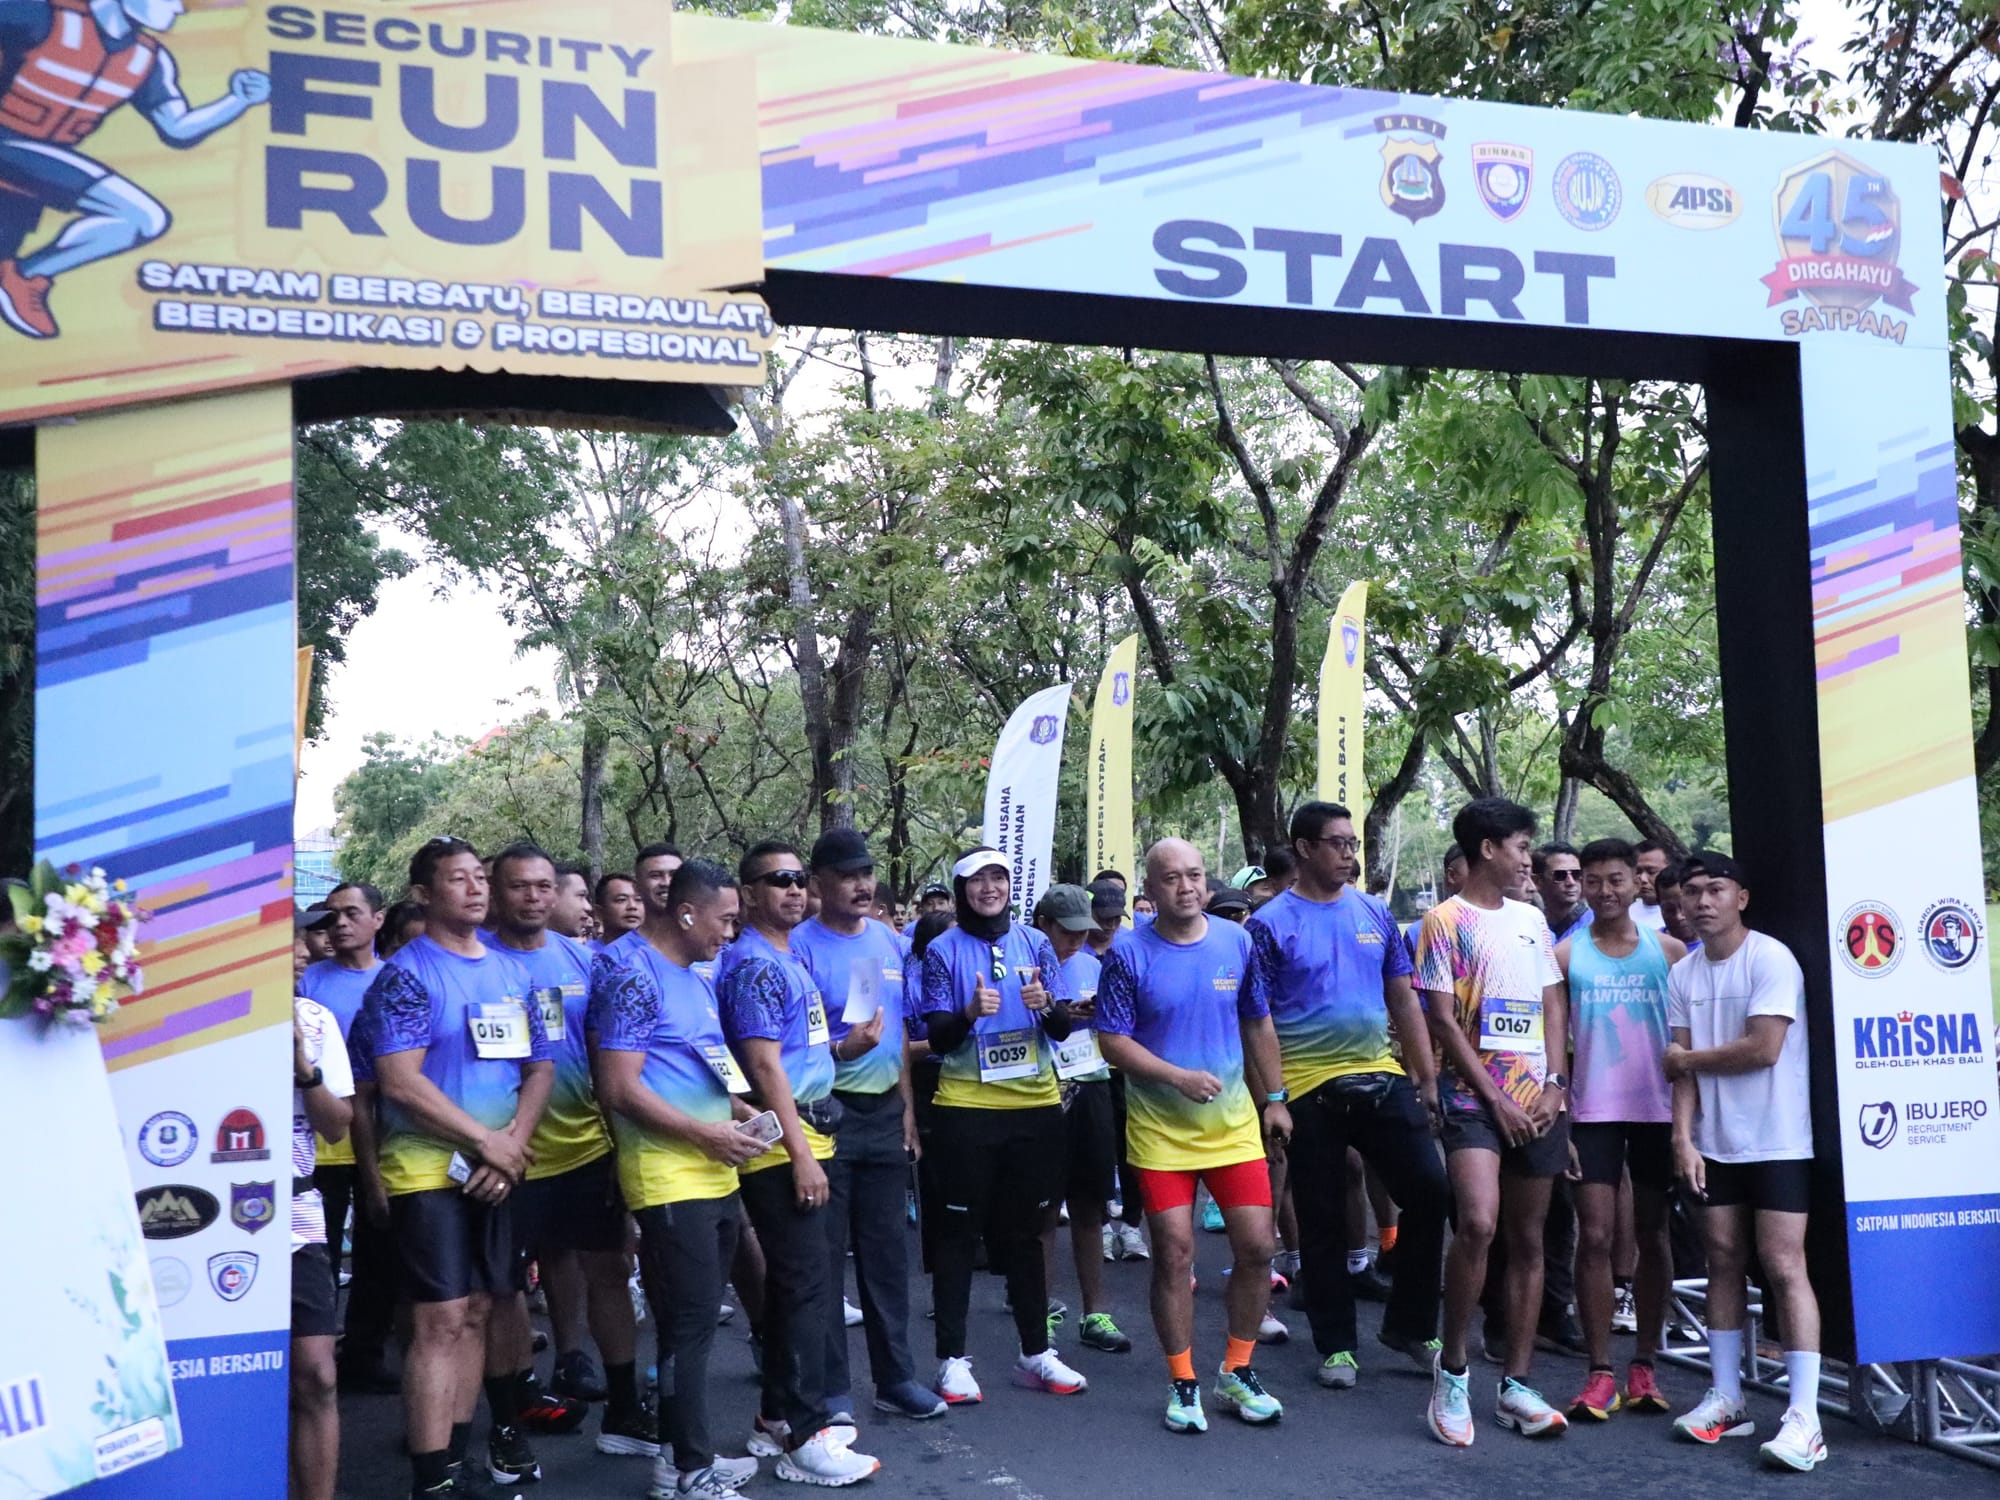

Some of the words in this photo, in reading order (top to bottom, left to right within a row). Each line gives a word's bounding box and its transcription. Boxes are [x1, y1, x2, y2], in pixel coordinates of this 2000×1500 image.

[266, 4, 653, 78] SECURITY
[269, 50, 657, 169] FUN
[1383, 116, 1437, 134] BALI
[1479, 147, 1526, 160] BINMAS
[265, 144, 663, 259] RUN
[1780, 171, 1891, 257] 45
[1867, 181, 1880, 193] TH
[1152, 219, 1616, 324] START
[1787, 261, 1893, 288] DIRGAHAYU
[140, 260, 320, 298] SATPAM
[331, 274, 530, 317] BERSATU,
[541, 289, 773, 334] BERDAULAT,
[157, 301, 444, 343] BERDEDIKASI
[455, 320, 483, 344] &
[495, 322, 761, 363] PROFESIONAL
[1780, 305, 1908, 345] SATPAM
[1338, 716, 1346, 766] BALI
[1000, 786, 1011, 832] USAHA
[1012, 804, 1025, 901] PENGAMANAN
[1938, 897, 1961, 905] WIRA
[1494, 1017, 1531, 1034] 0167
[988, 1045, 1027, 1064] 0039
[1855, 1058, 1920, 1069] OLEH-OLEH
[1923, 1057, 1955, 1066] KHAS
[1958, 1056, 1984, 1064] BALI
[1906, 1102, 1937, 1120] IBU
[1940, 1099, 1987, 1121] JERO
[1907, 1122, 1973, 1134] RECRUITMENT
[1907, 1134, 1947, 1145] SERVICE
[1856, 1214, 1899, 1232] SATPAM
[1901, 1211, 1956, 1229] INDONESIA
[210, 1350, 284, 1376] BERSATU
